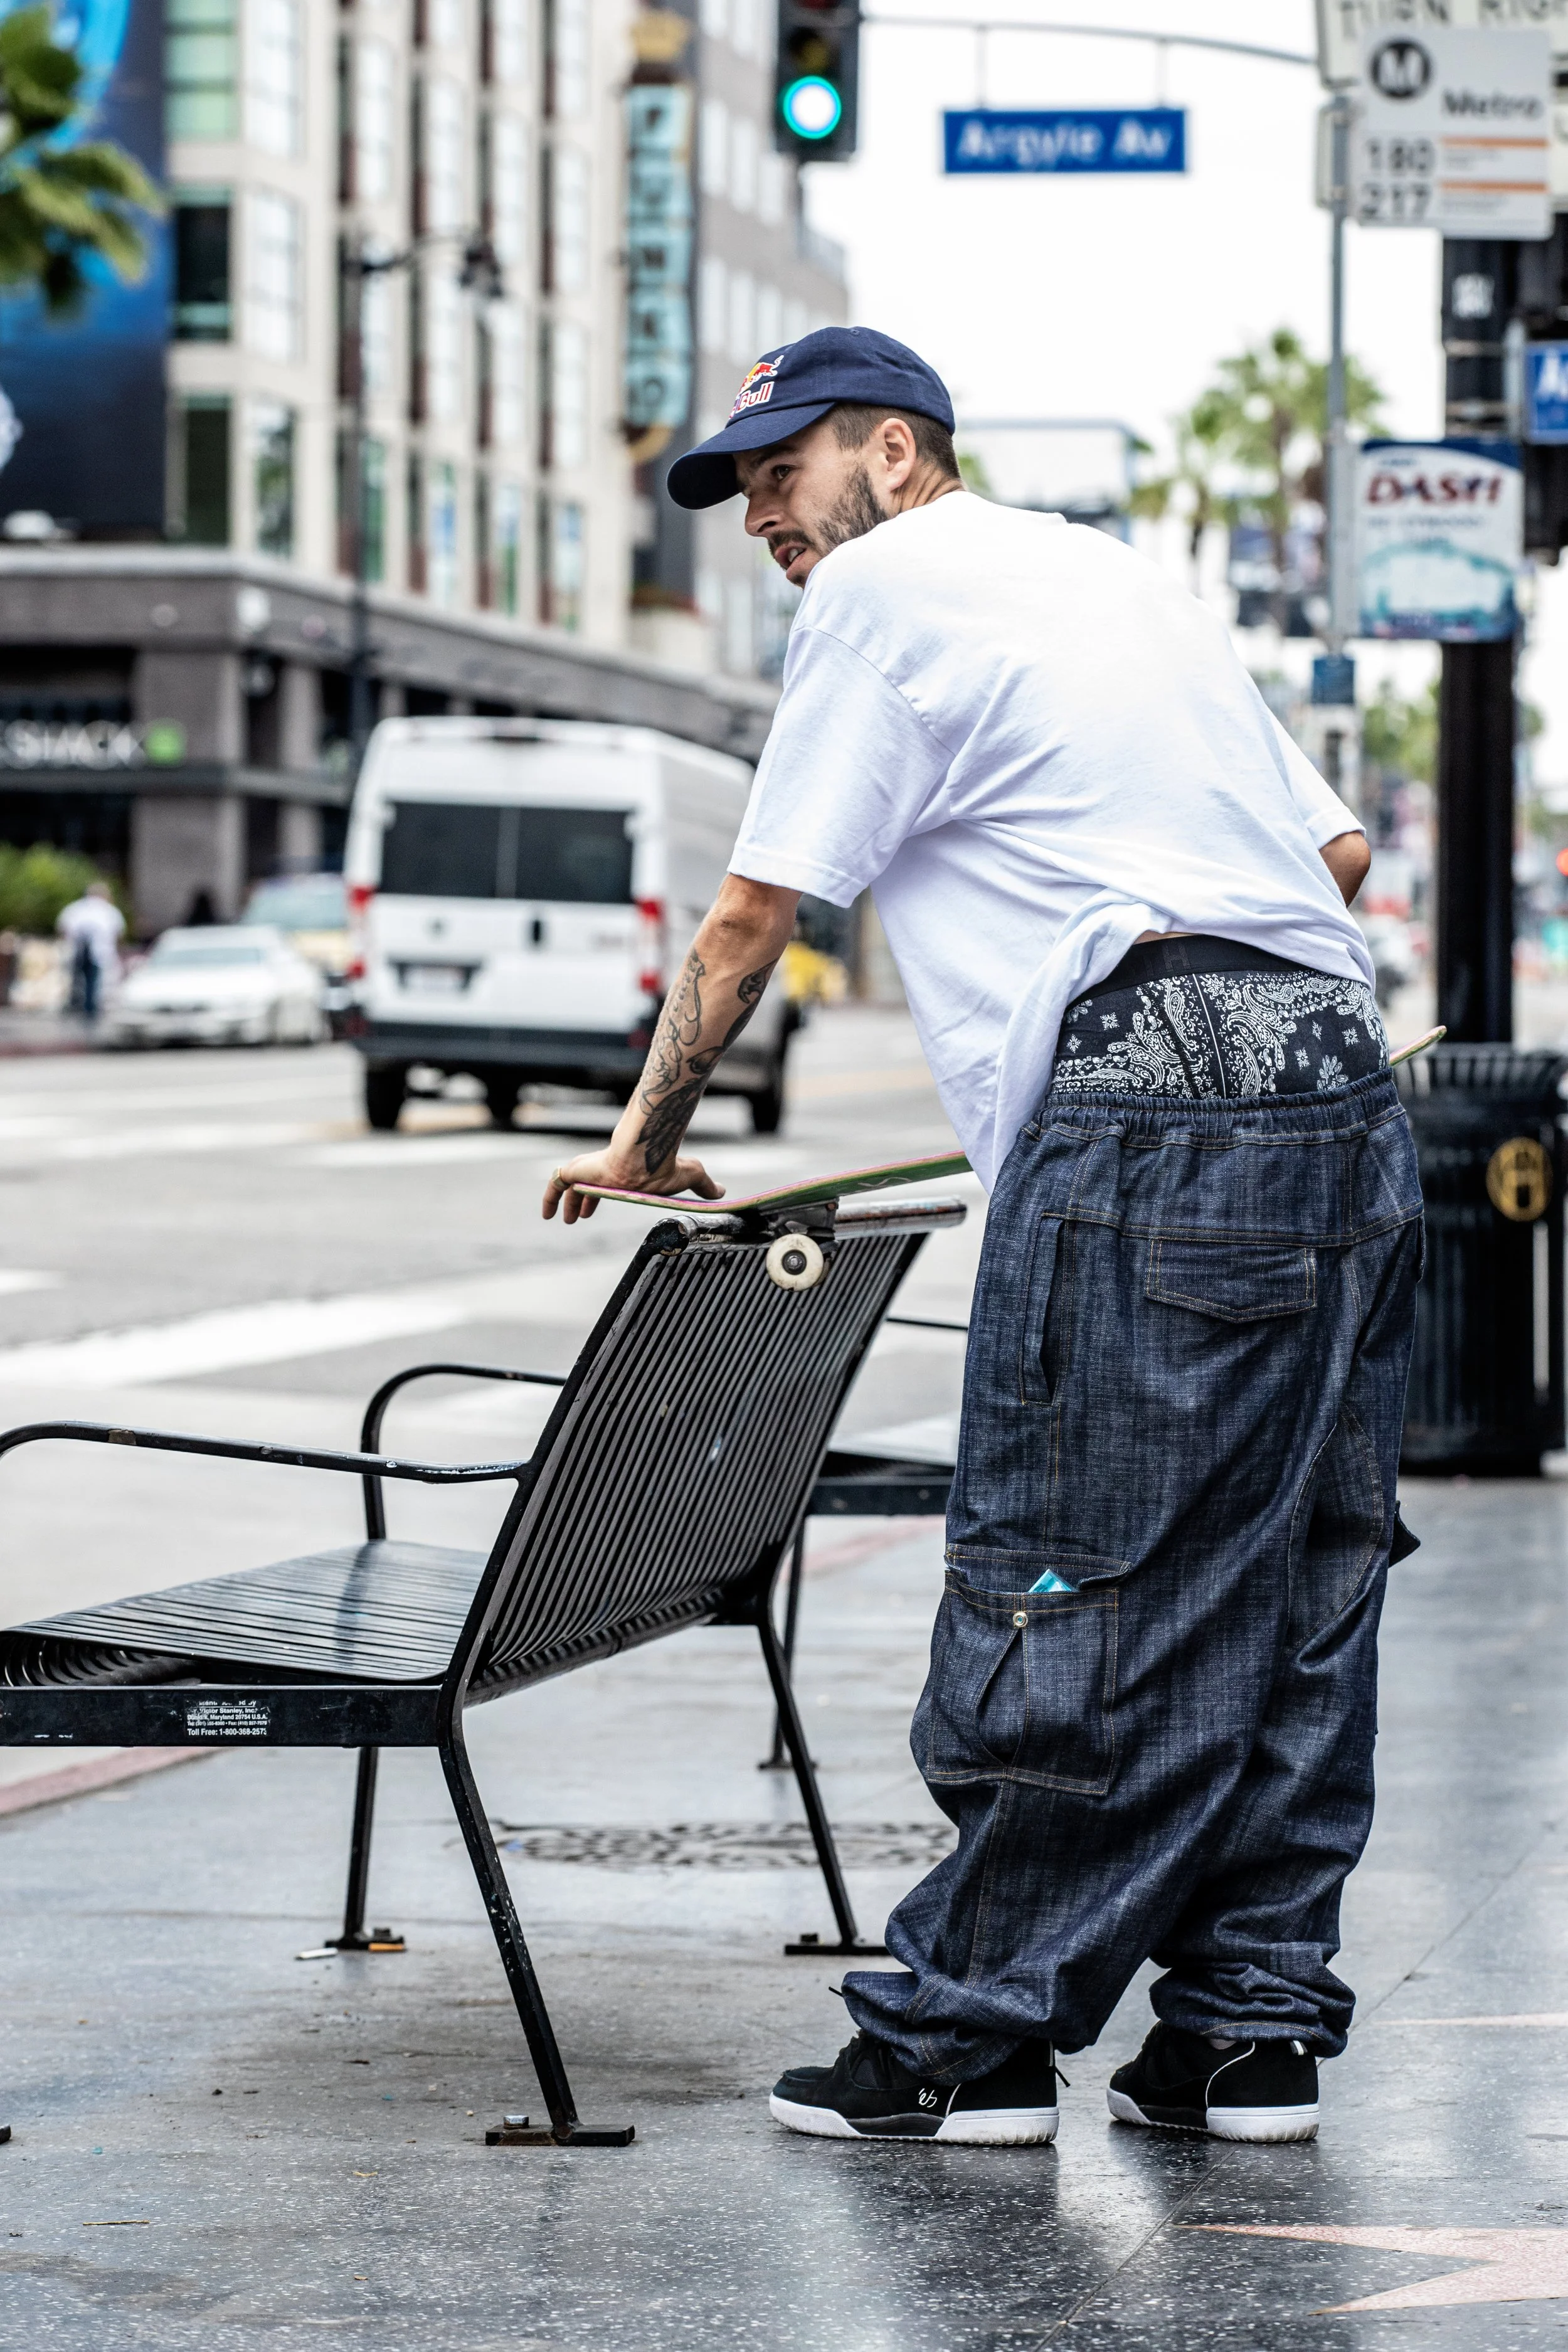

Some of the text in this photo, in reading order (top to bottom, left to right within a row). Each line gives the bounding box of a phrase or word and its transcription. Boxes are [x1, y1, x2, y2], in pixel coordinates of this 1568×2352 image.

[1444, 90, 1544, 119] Metro
[958, 118, 1172, 167] Argyle Av
[1365, 138, 1435, 176] 180
[1360, 183, 1433, 220] 217
[1367, 474, 1502, 504] DASH
